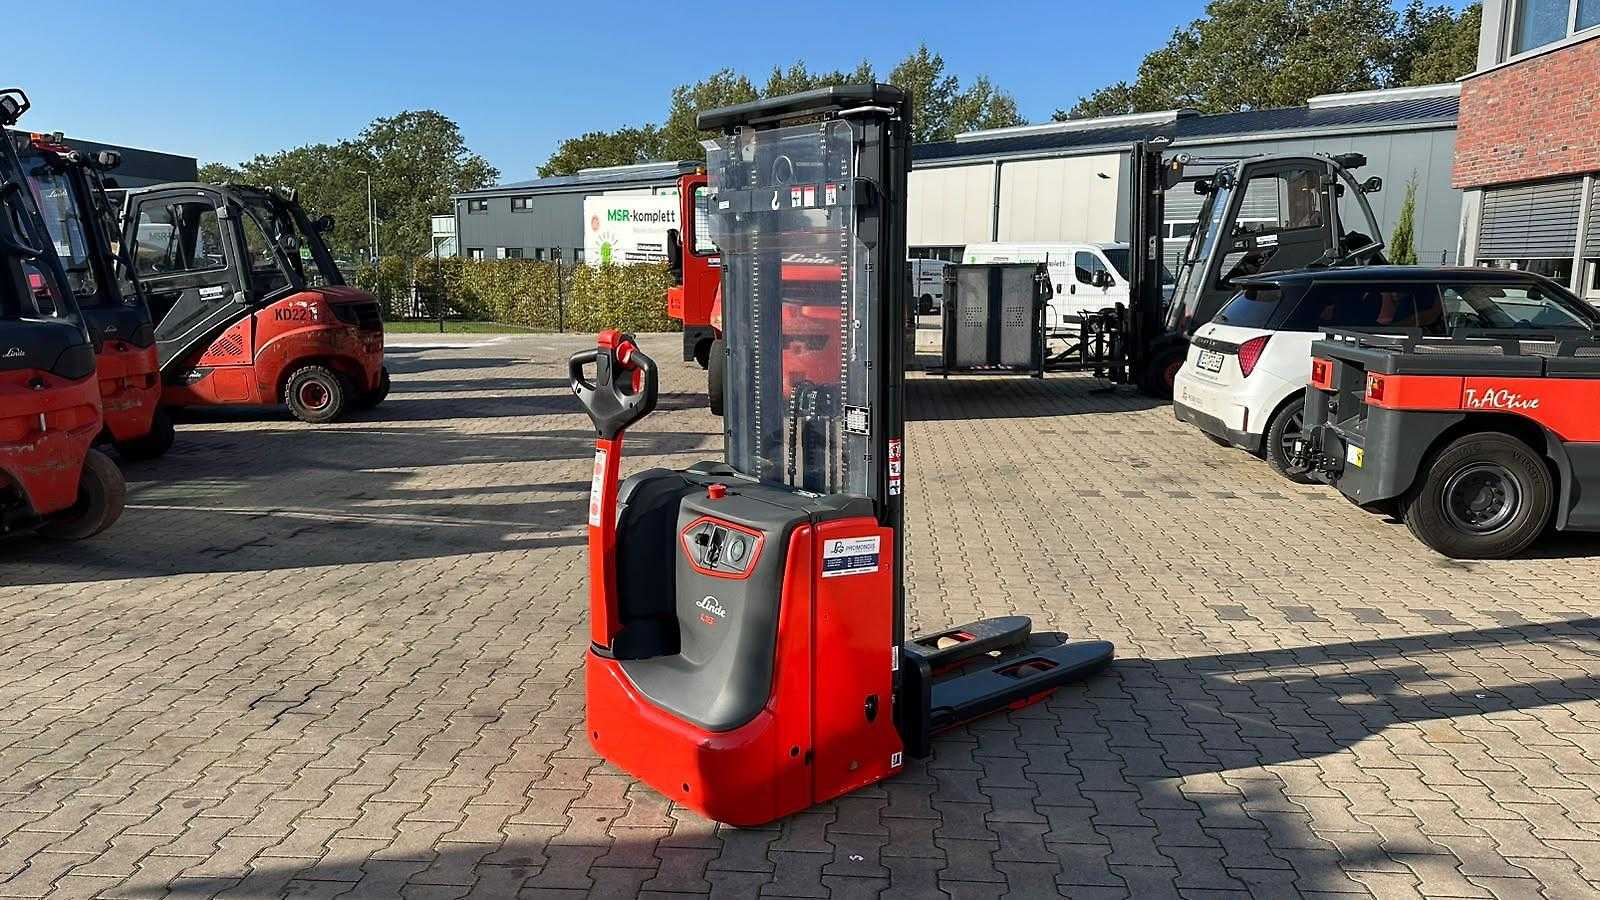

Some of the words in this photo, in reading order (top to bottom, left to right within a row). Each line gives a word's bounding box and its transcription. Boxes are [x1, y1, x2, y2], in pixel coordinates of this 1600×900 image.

[607, 208, 676, 224] MSR-komplett
[1465, 388, 1540, 409] TrACtive
[695, 595, 727, 618] Linde
